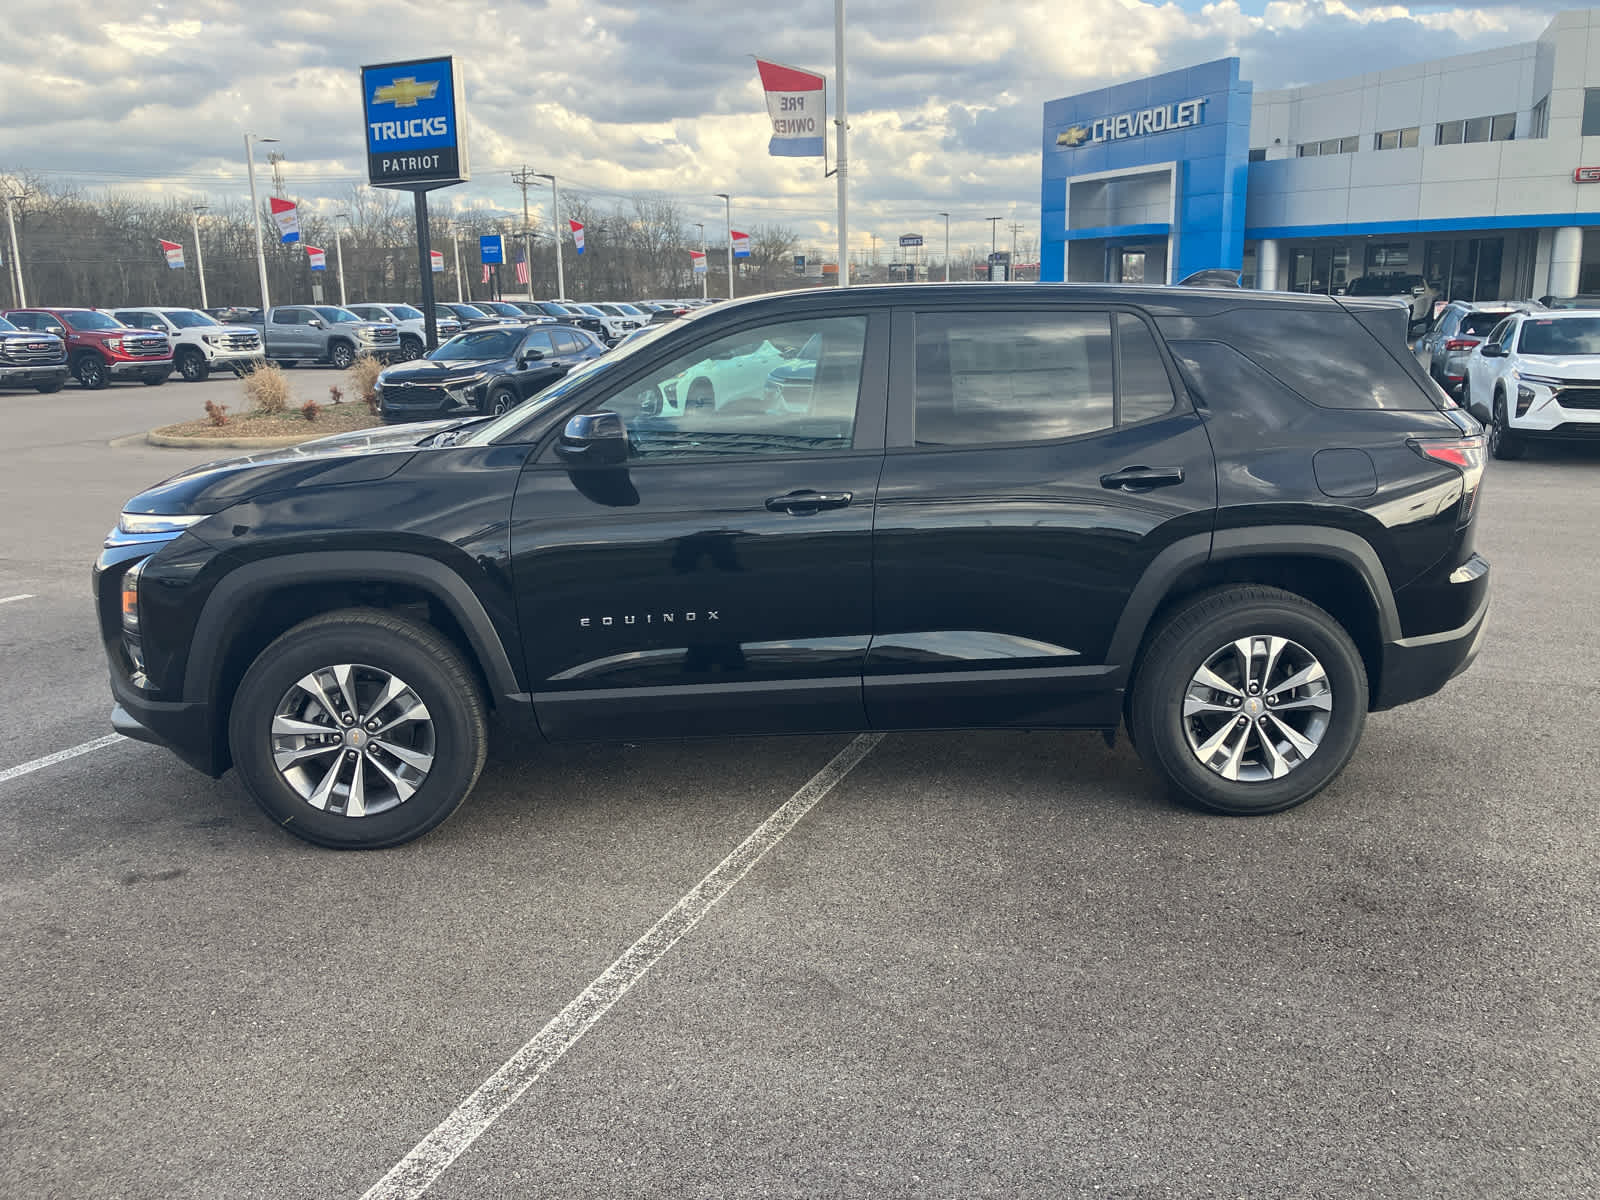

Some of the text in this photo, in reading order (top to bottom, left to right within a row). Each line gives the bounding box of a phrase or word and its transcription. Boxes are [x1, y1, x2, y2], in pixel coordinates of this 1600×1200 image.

[370, 116, 447, 141] TRUCKS
[1092, 98, 1206, 143] CHEVROLET
[382, 155, 440, 172] PATRIOT
[580, 611, 719, 627] EQUINOX
